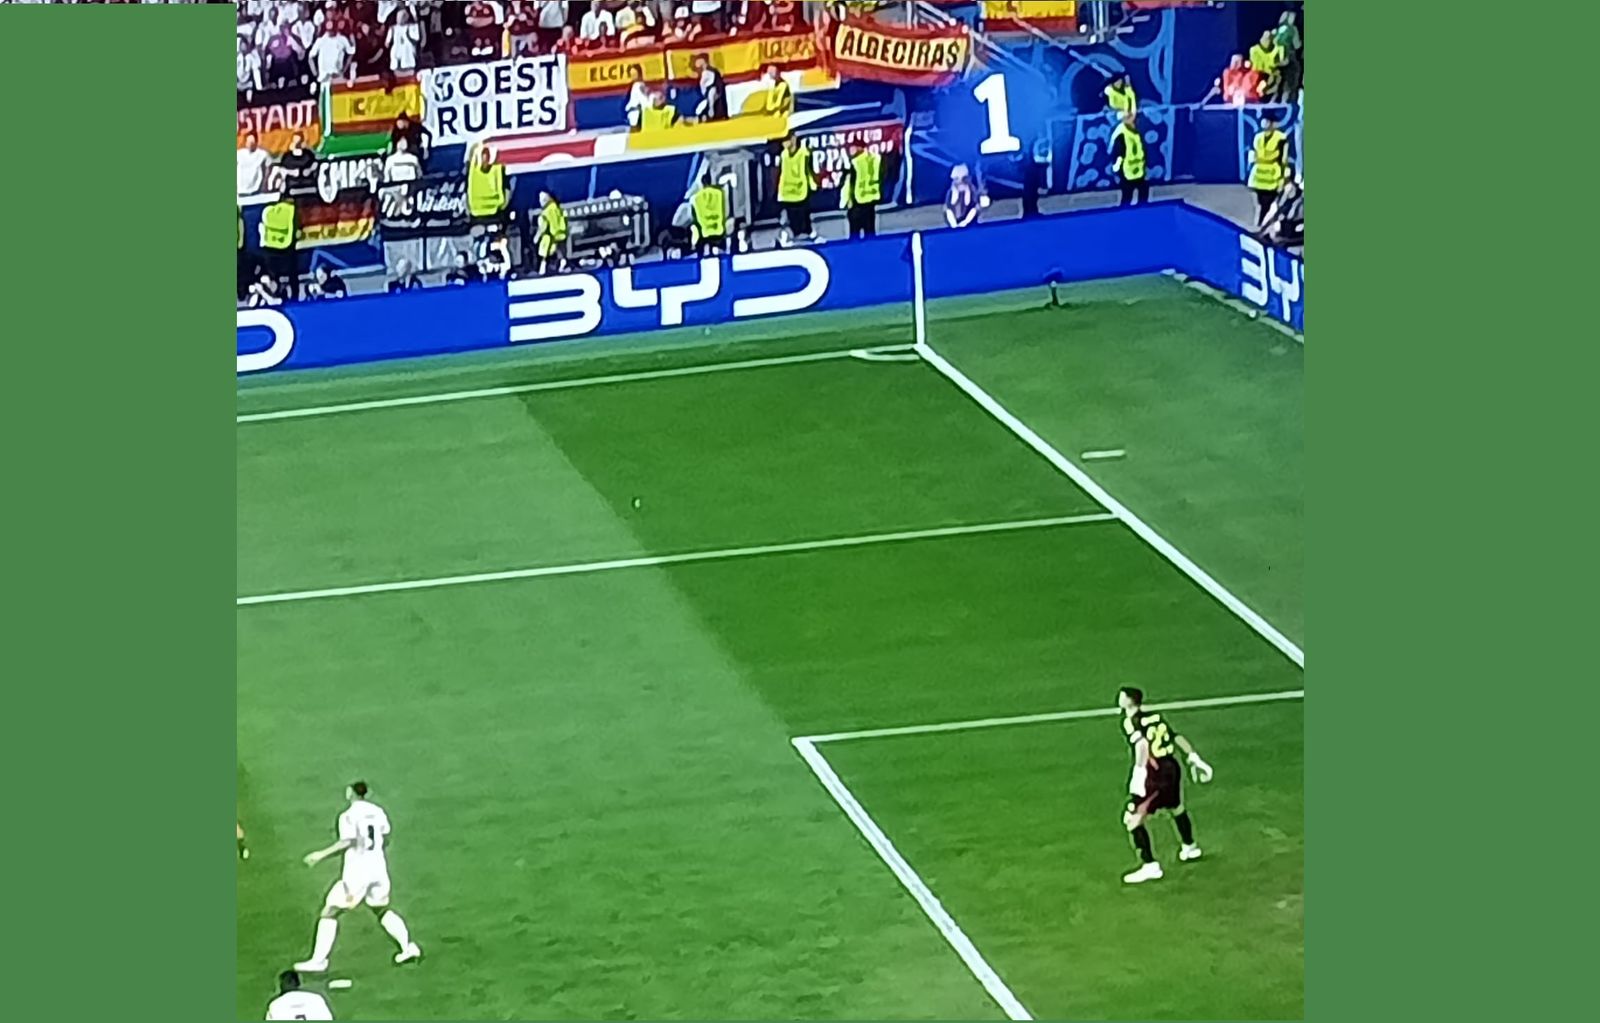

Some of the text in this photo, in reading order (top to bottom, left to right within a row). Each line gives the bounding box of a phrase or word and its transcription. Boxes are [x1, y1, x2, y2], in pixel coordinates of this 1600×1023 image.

[437, 96, 557, 137] RULES
[973, 73, 1021, 154] 1
[507, 248, 830, 342] BYD
[1239, 233, 1304, 323] BY
